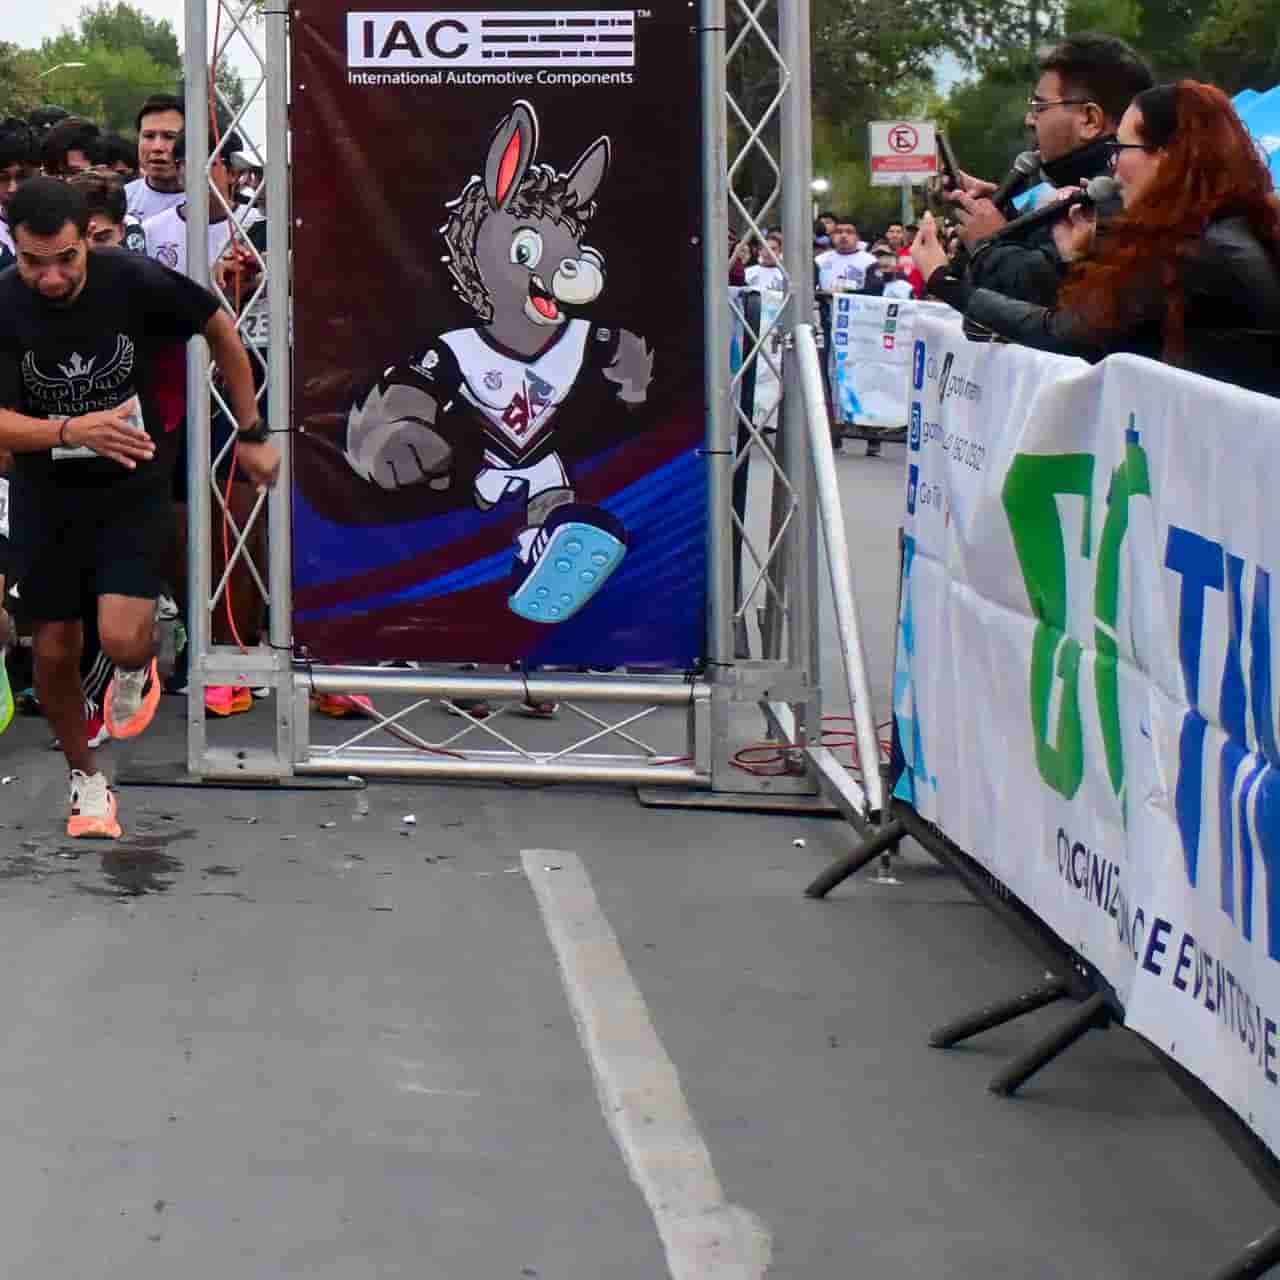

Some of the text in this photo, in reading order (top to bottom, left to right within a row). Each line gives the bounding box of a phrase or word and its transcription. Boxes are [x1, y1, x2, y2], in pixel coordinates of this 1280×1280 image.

[363, 19, 469, 58] IAC
[348, 70, 633, 86] International Automotive Components
